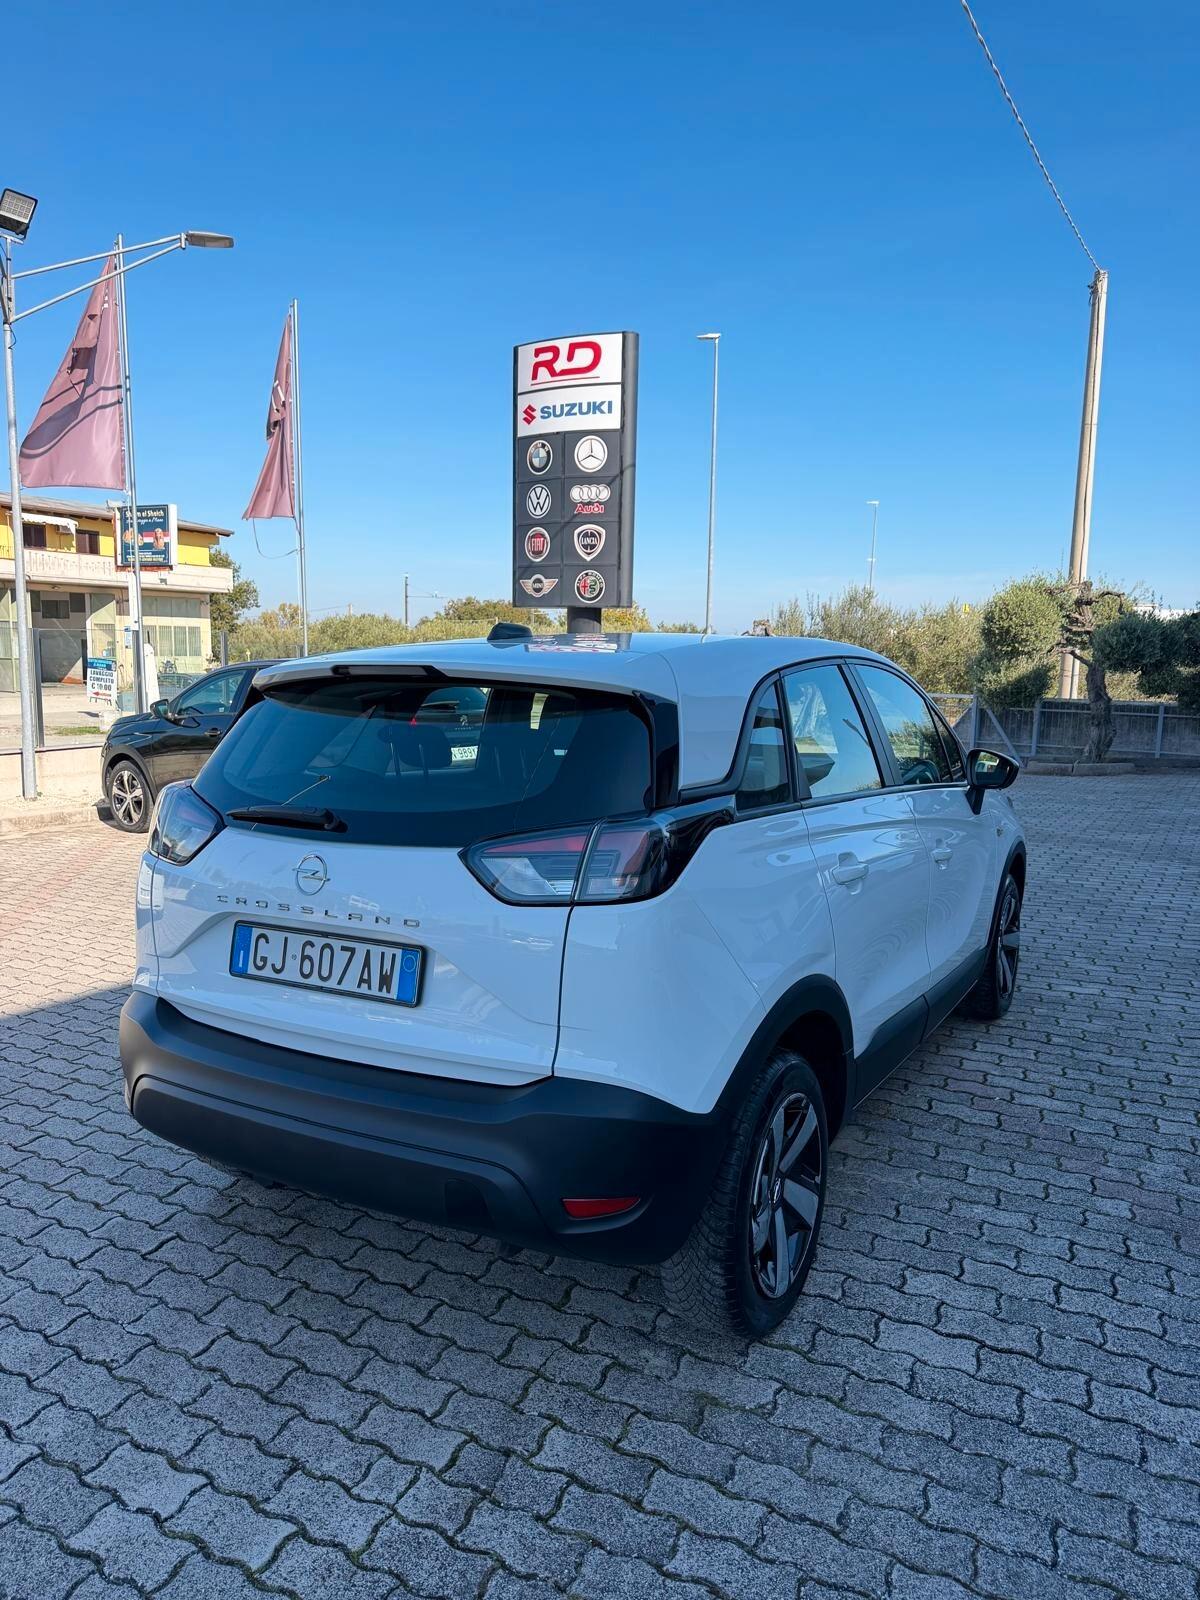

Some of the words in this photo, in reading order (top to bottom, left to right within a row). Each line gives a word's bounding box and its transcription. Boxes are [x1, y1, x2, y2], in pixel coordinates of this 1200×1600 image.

[531, 341, 603, 381] RD
[540, 400, 613, 420] SUZUKI
[574, 502, 604, 513] Audi
[531, 537, 545, 551] FIAT
[581, 537, 598, 545] LANCIA
[216, 894, 421, 928] CROSSLAND
[252, 932, 289, 975] GJ
[299, 939, 397, 994] 607AW
